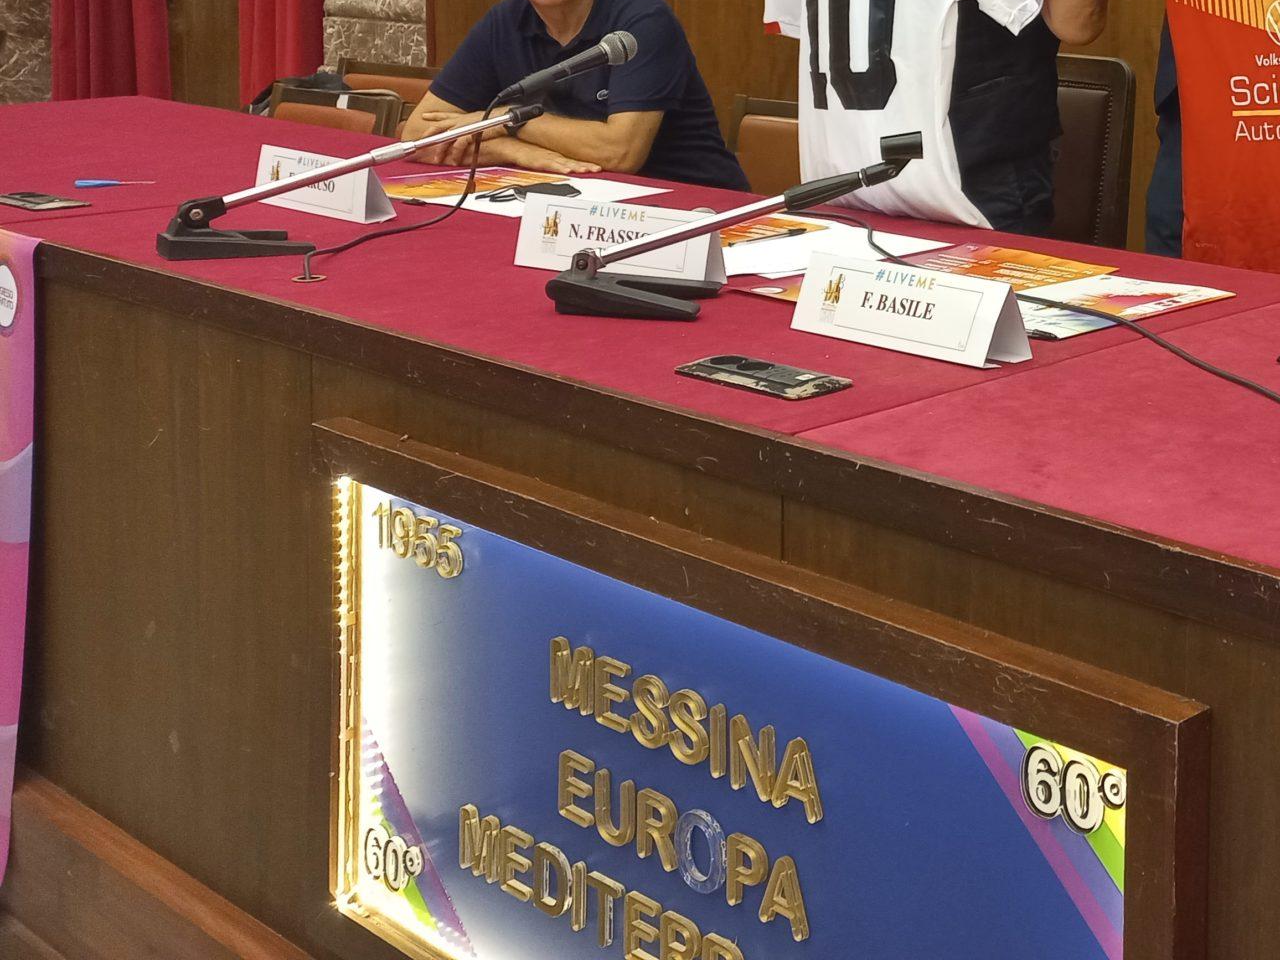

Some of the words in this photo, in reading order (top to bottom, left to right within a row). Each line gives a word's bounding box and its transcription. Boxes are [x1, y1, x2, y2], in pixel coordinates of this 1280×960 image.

[589, 205, 647, 222] #LIVEME
[569, 223, 583, 239] N.
[875, 269, 936, 290] #LIVEME
[861, 291, 874, 309] F.
[876, 295, 936, 320] BASILE
[371, 502, 465, 579] 1955
[549, 636, 824, 824] MESSINA
[557, 749, 810, 942] EUROPA
